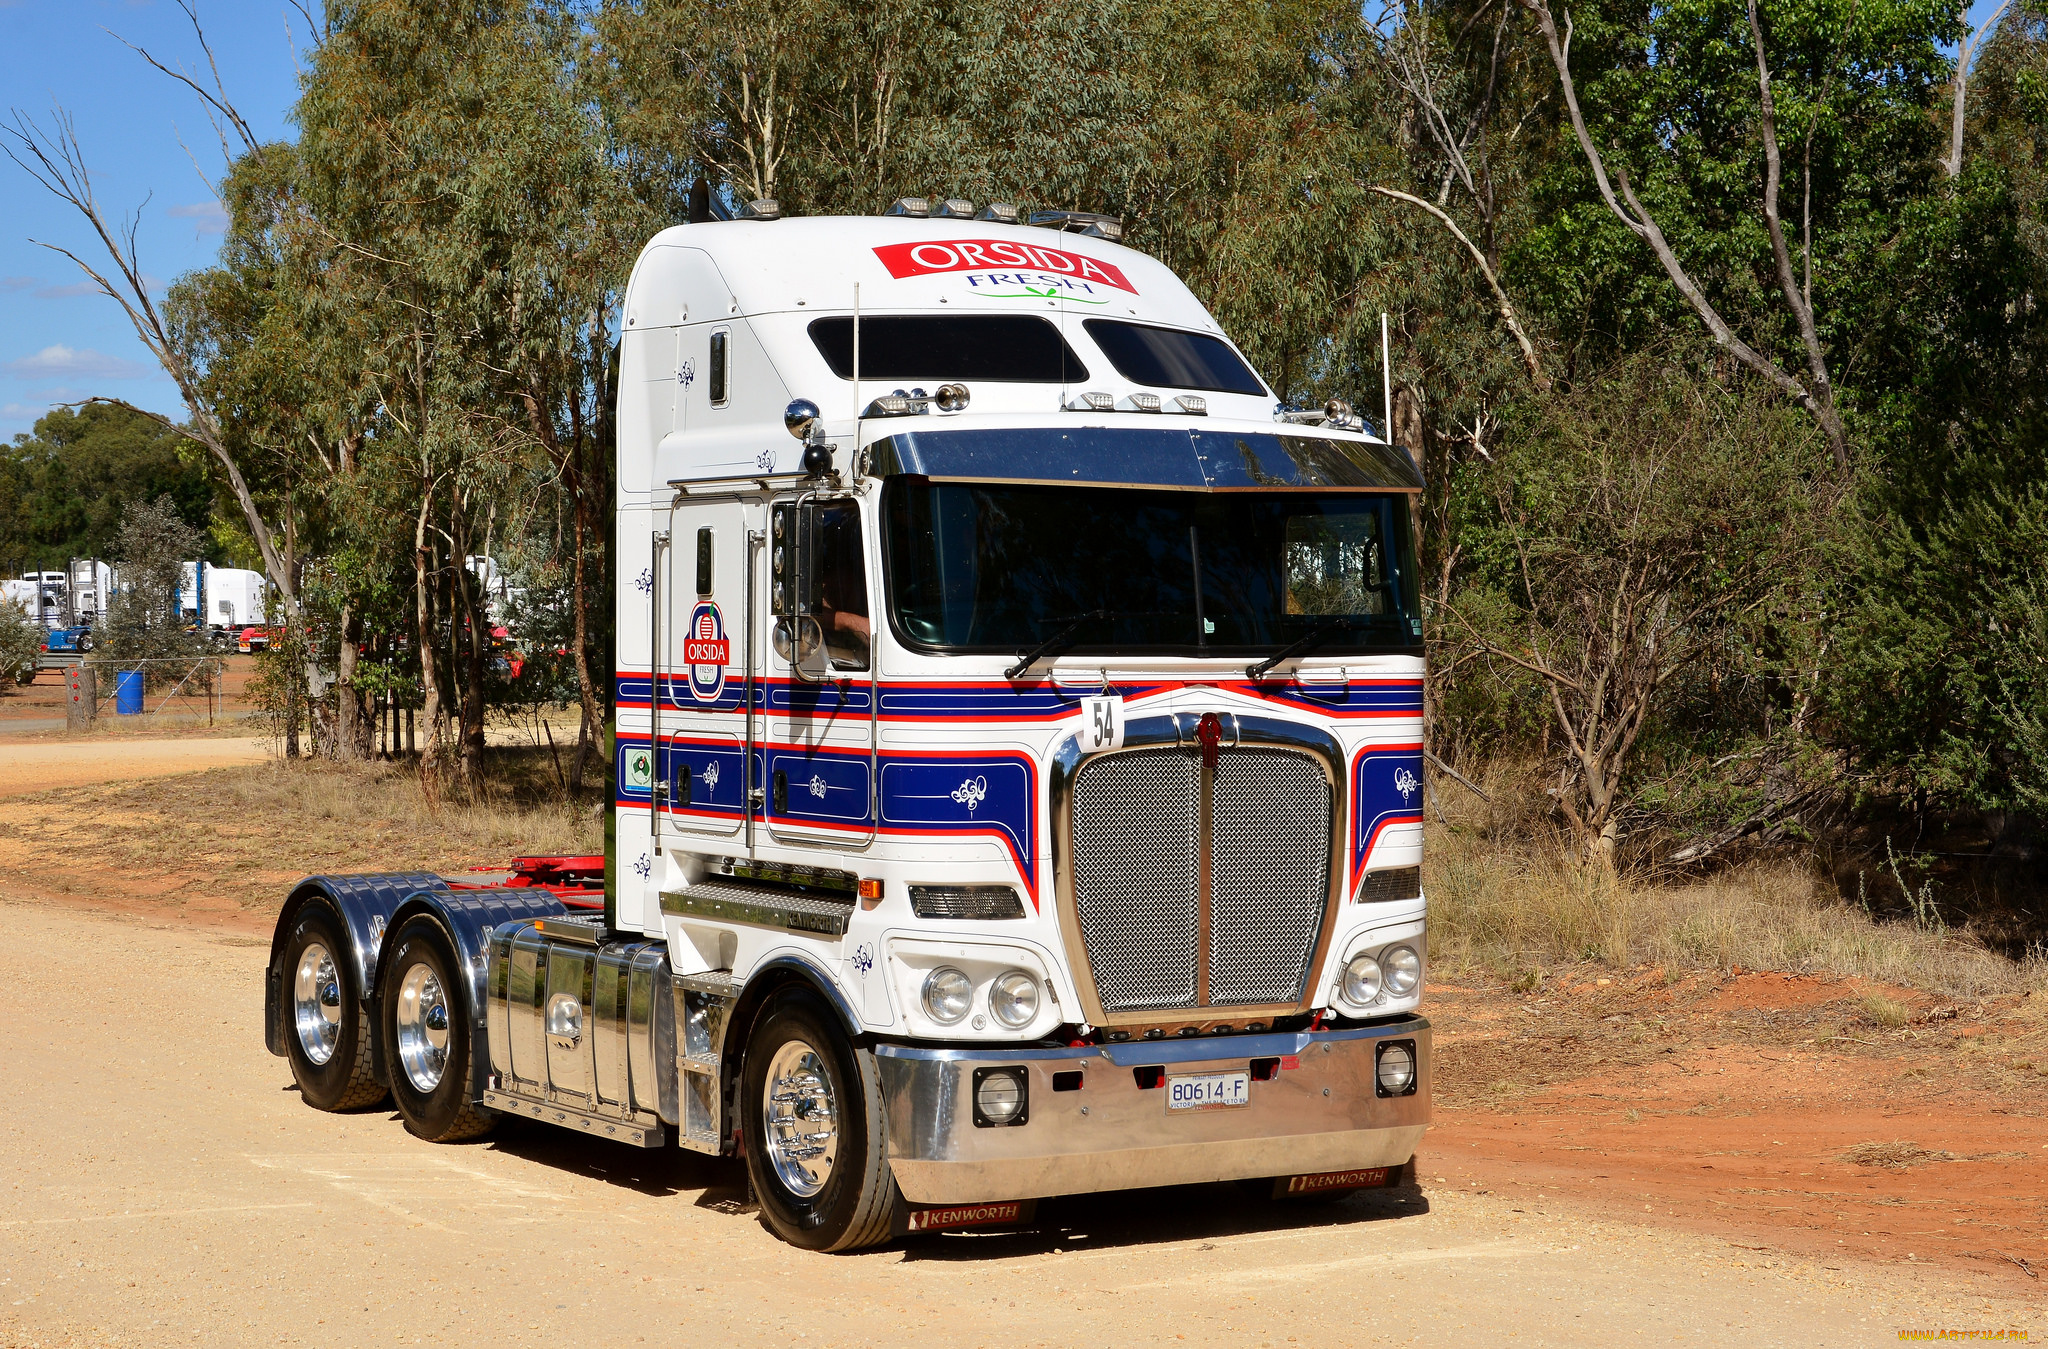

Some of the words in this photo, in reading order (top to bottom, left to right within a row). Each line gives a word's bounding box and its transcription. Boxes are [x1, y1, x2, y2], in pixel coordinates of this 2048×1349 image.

[911, 243, 1119, 285] ORSIDA
[966, 273, 1094, 294] FRESH
[688, 644, 726, 660] ORSIDA
[700, 665, 713, 674] FRESH
[1093, 701, 1114, 748] 54
[1307, 1171, 1385, 1188] KENWORTH
[930, 1206, 1017, 1225] KENWORTH
